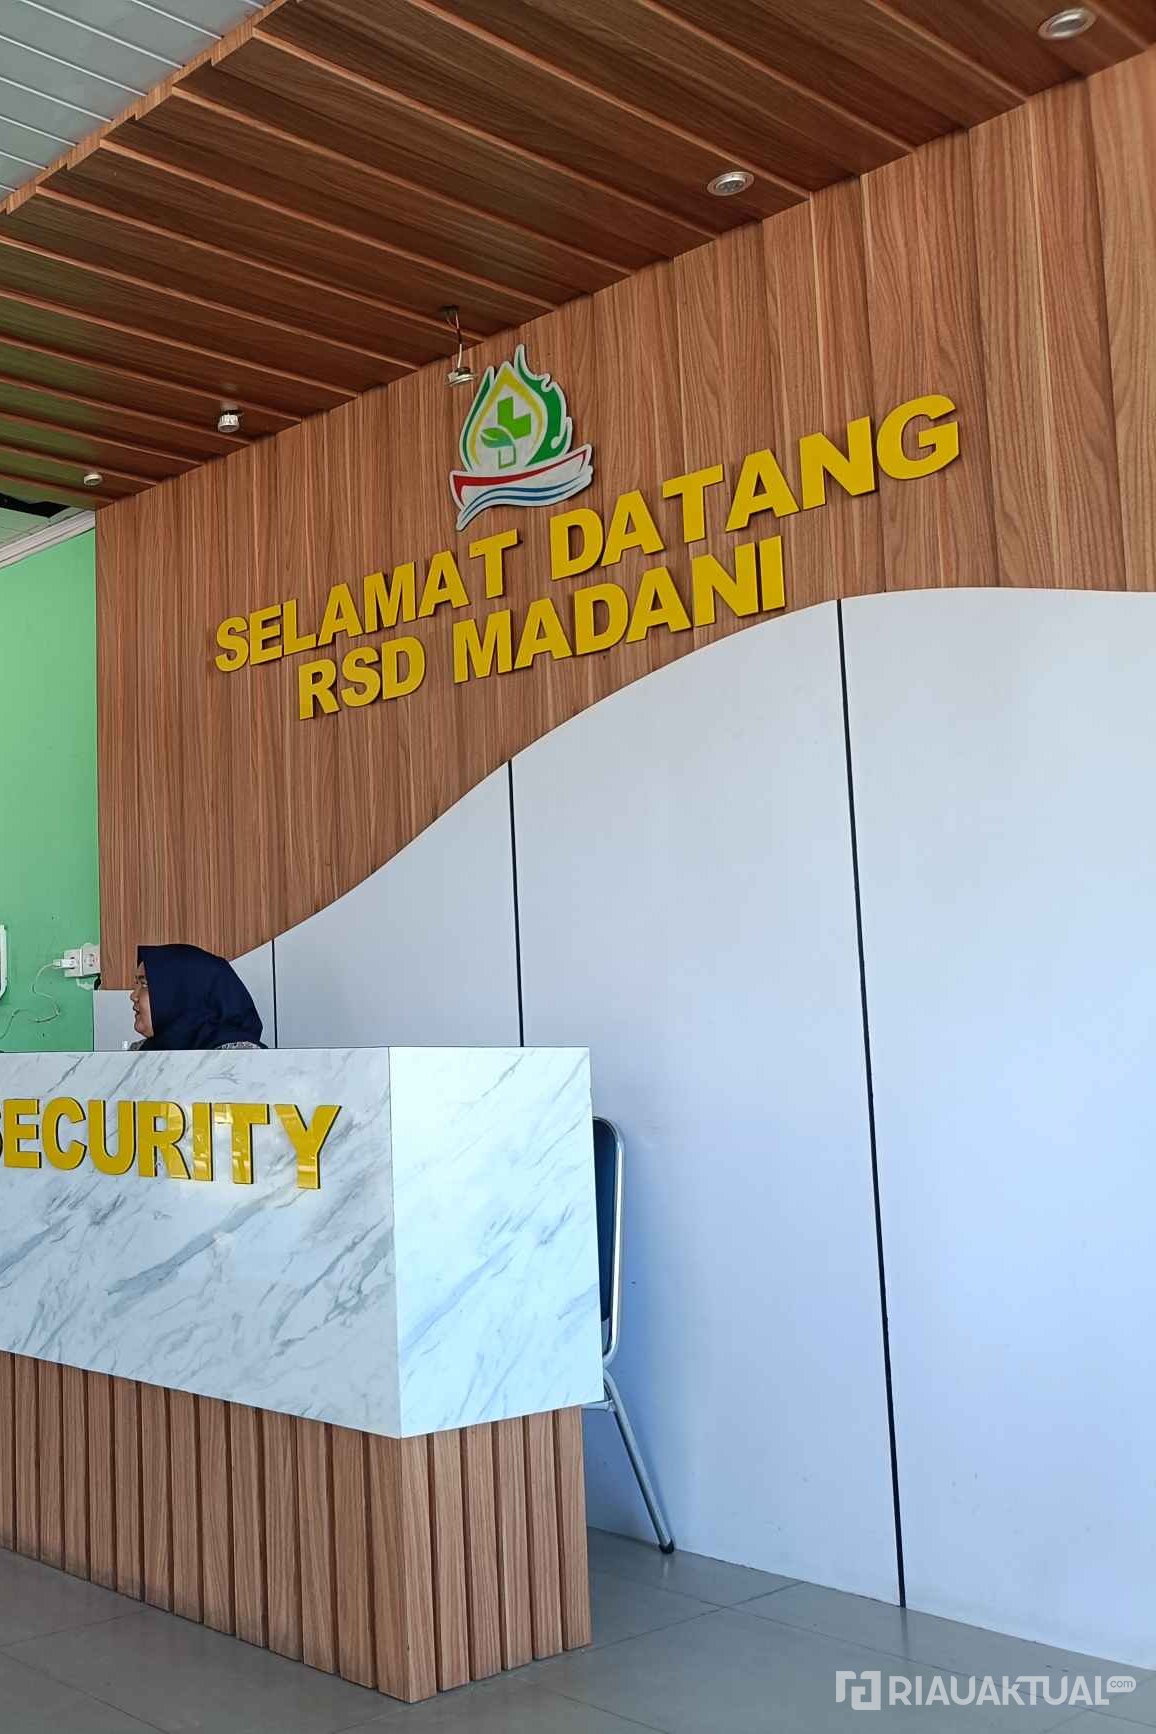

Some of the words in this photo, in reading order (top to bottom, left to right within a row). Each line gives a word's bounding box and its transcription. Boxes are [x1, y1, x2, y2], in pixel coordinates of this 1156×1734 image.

[215, 529, 519, 672] SELAMAT
[549, 394, 961, 581] DATANG
[298, 635, 426, 720] RSD
[453, 535, 786, 684] MADANI
